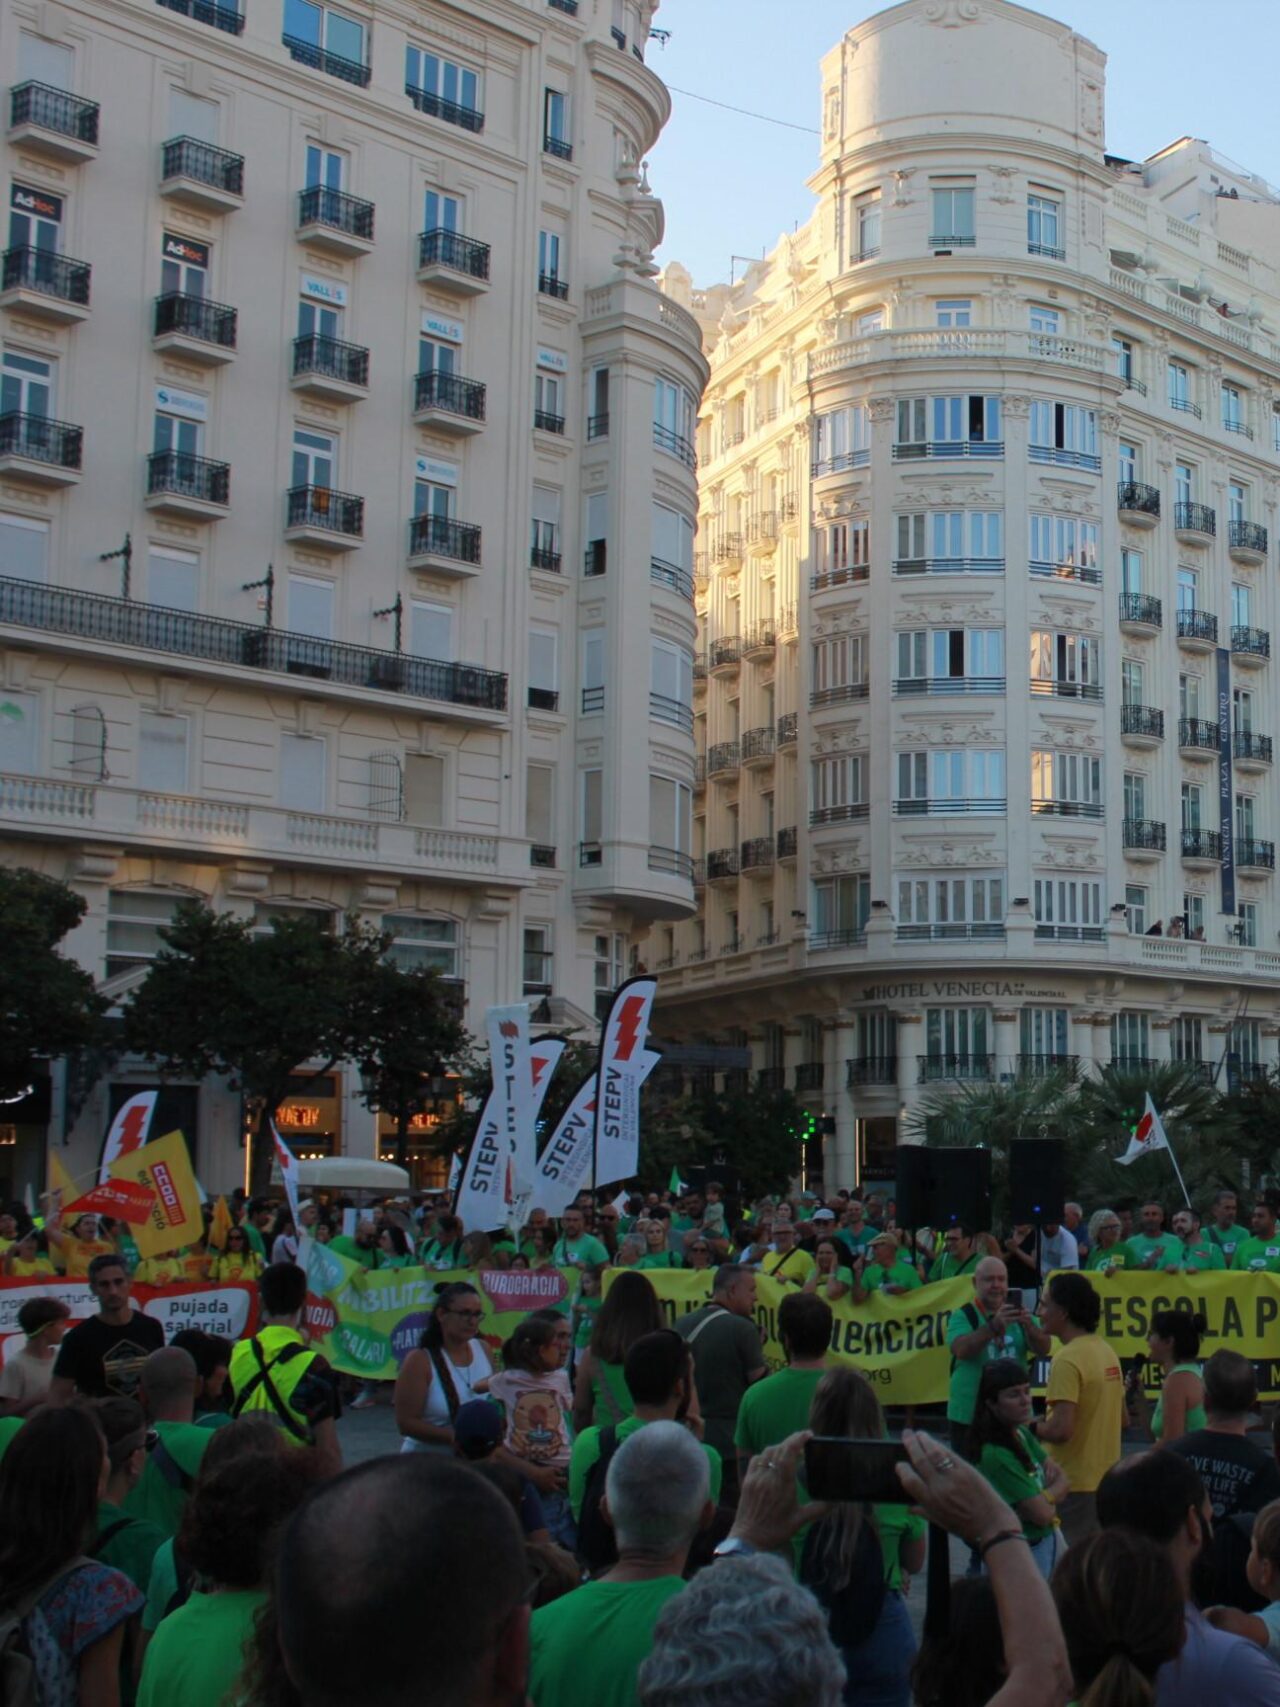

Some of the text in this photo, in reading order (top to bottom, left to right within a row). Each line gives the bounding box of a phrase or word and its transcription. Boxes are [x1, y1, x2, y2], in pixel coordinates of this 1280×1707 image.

[1219, 691, 1231, 870] VENECIA PLAZA CENTRO
[874, 981, 1014, 999] HOTEL VENECIA
[603, 1066, 623, 1139] STEPV
[542, 1112, 586, 1180] STEPV
[151, 1163, 178, 1207] CCOO
[169, 1299, 229, 1318] pujada
[165, 1318, 232, 1334] salarial
[1212, 1459, 1256, 1485] WASTE
[1213, 1477, 1239, 1495] LIFE
